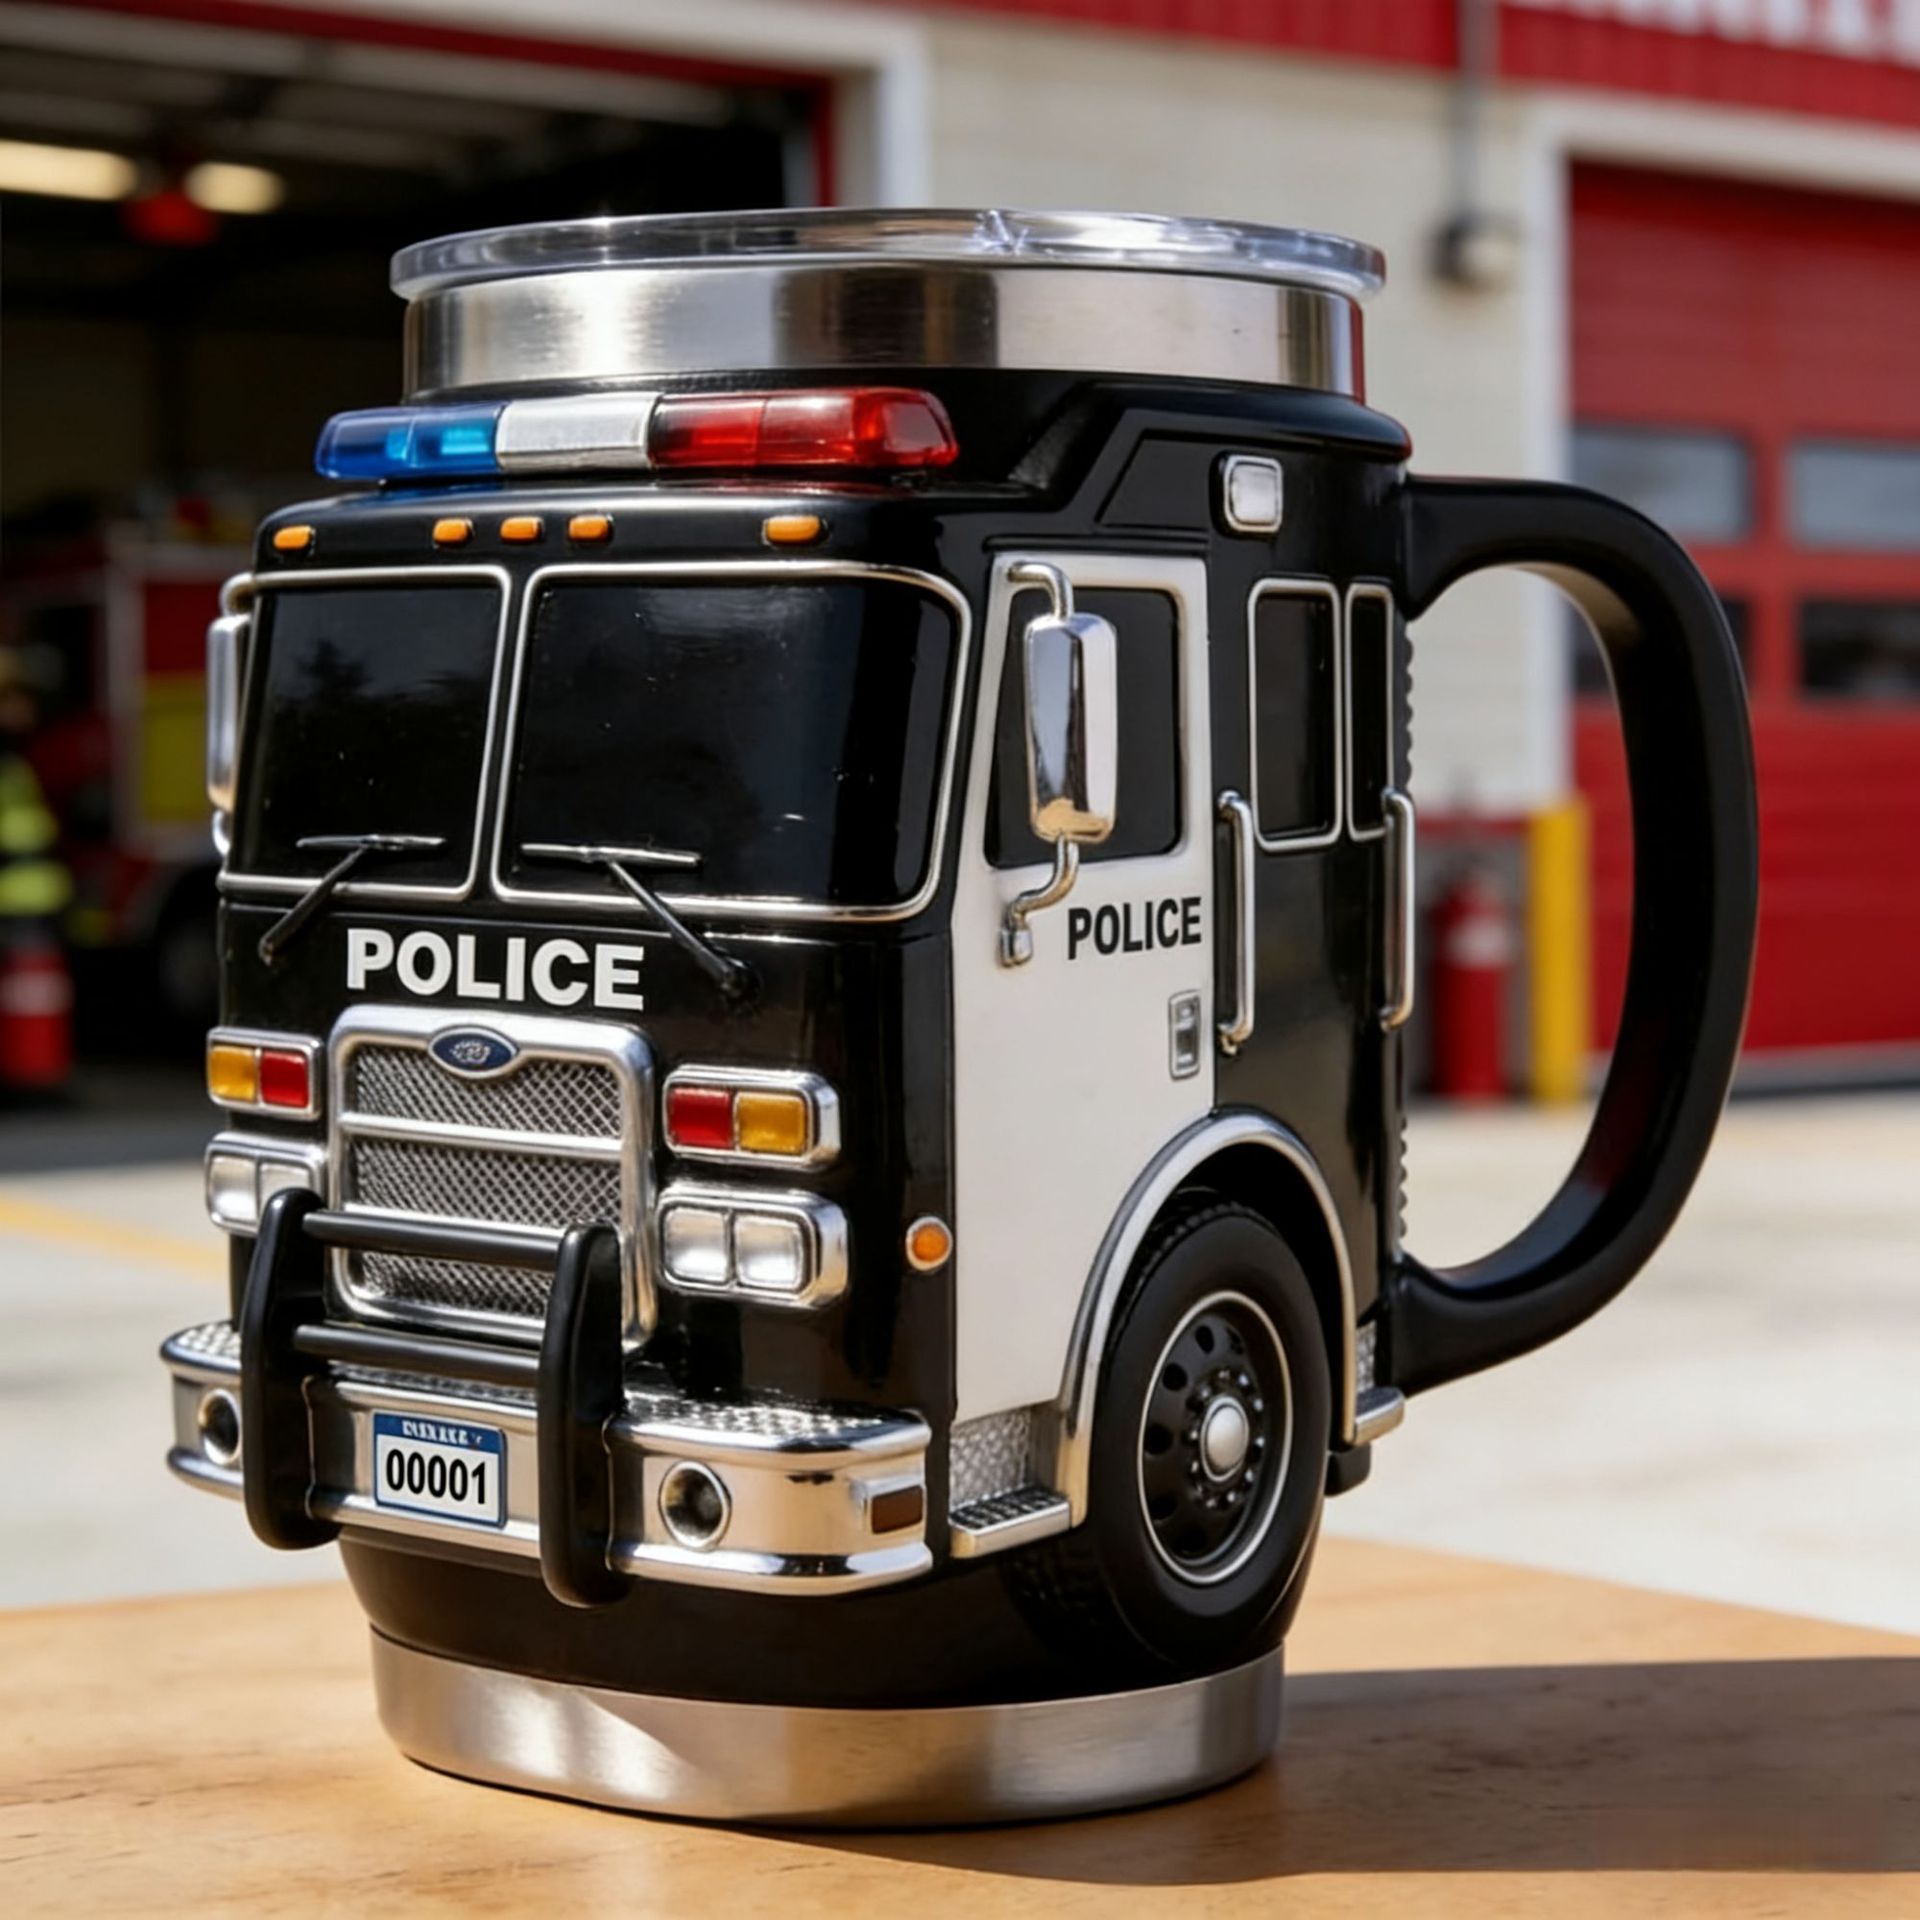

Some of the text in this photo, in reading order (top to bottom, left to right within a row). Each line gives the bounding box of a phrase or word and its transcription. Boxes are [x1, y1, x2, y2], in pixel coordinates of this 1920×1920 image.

[1068, 897, 1202, 960] POLICE
[347, 928, 645, 1010] POLICE
[386, 1448, 486, 1505] 00001
